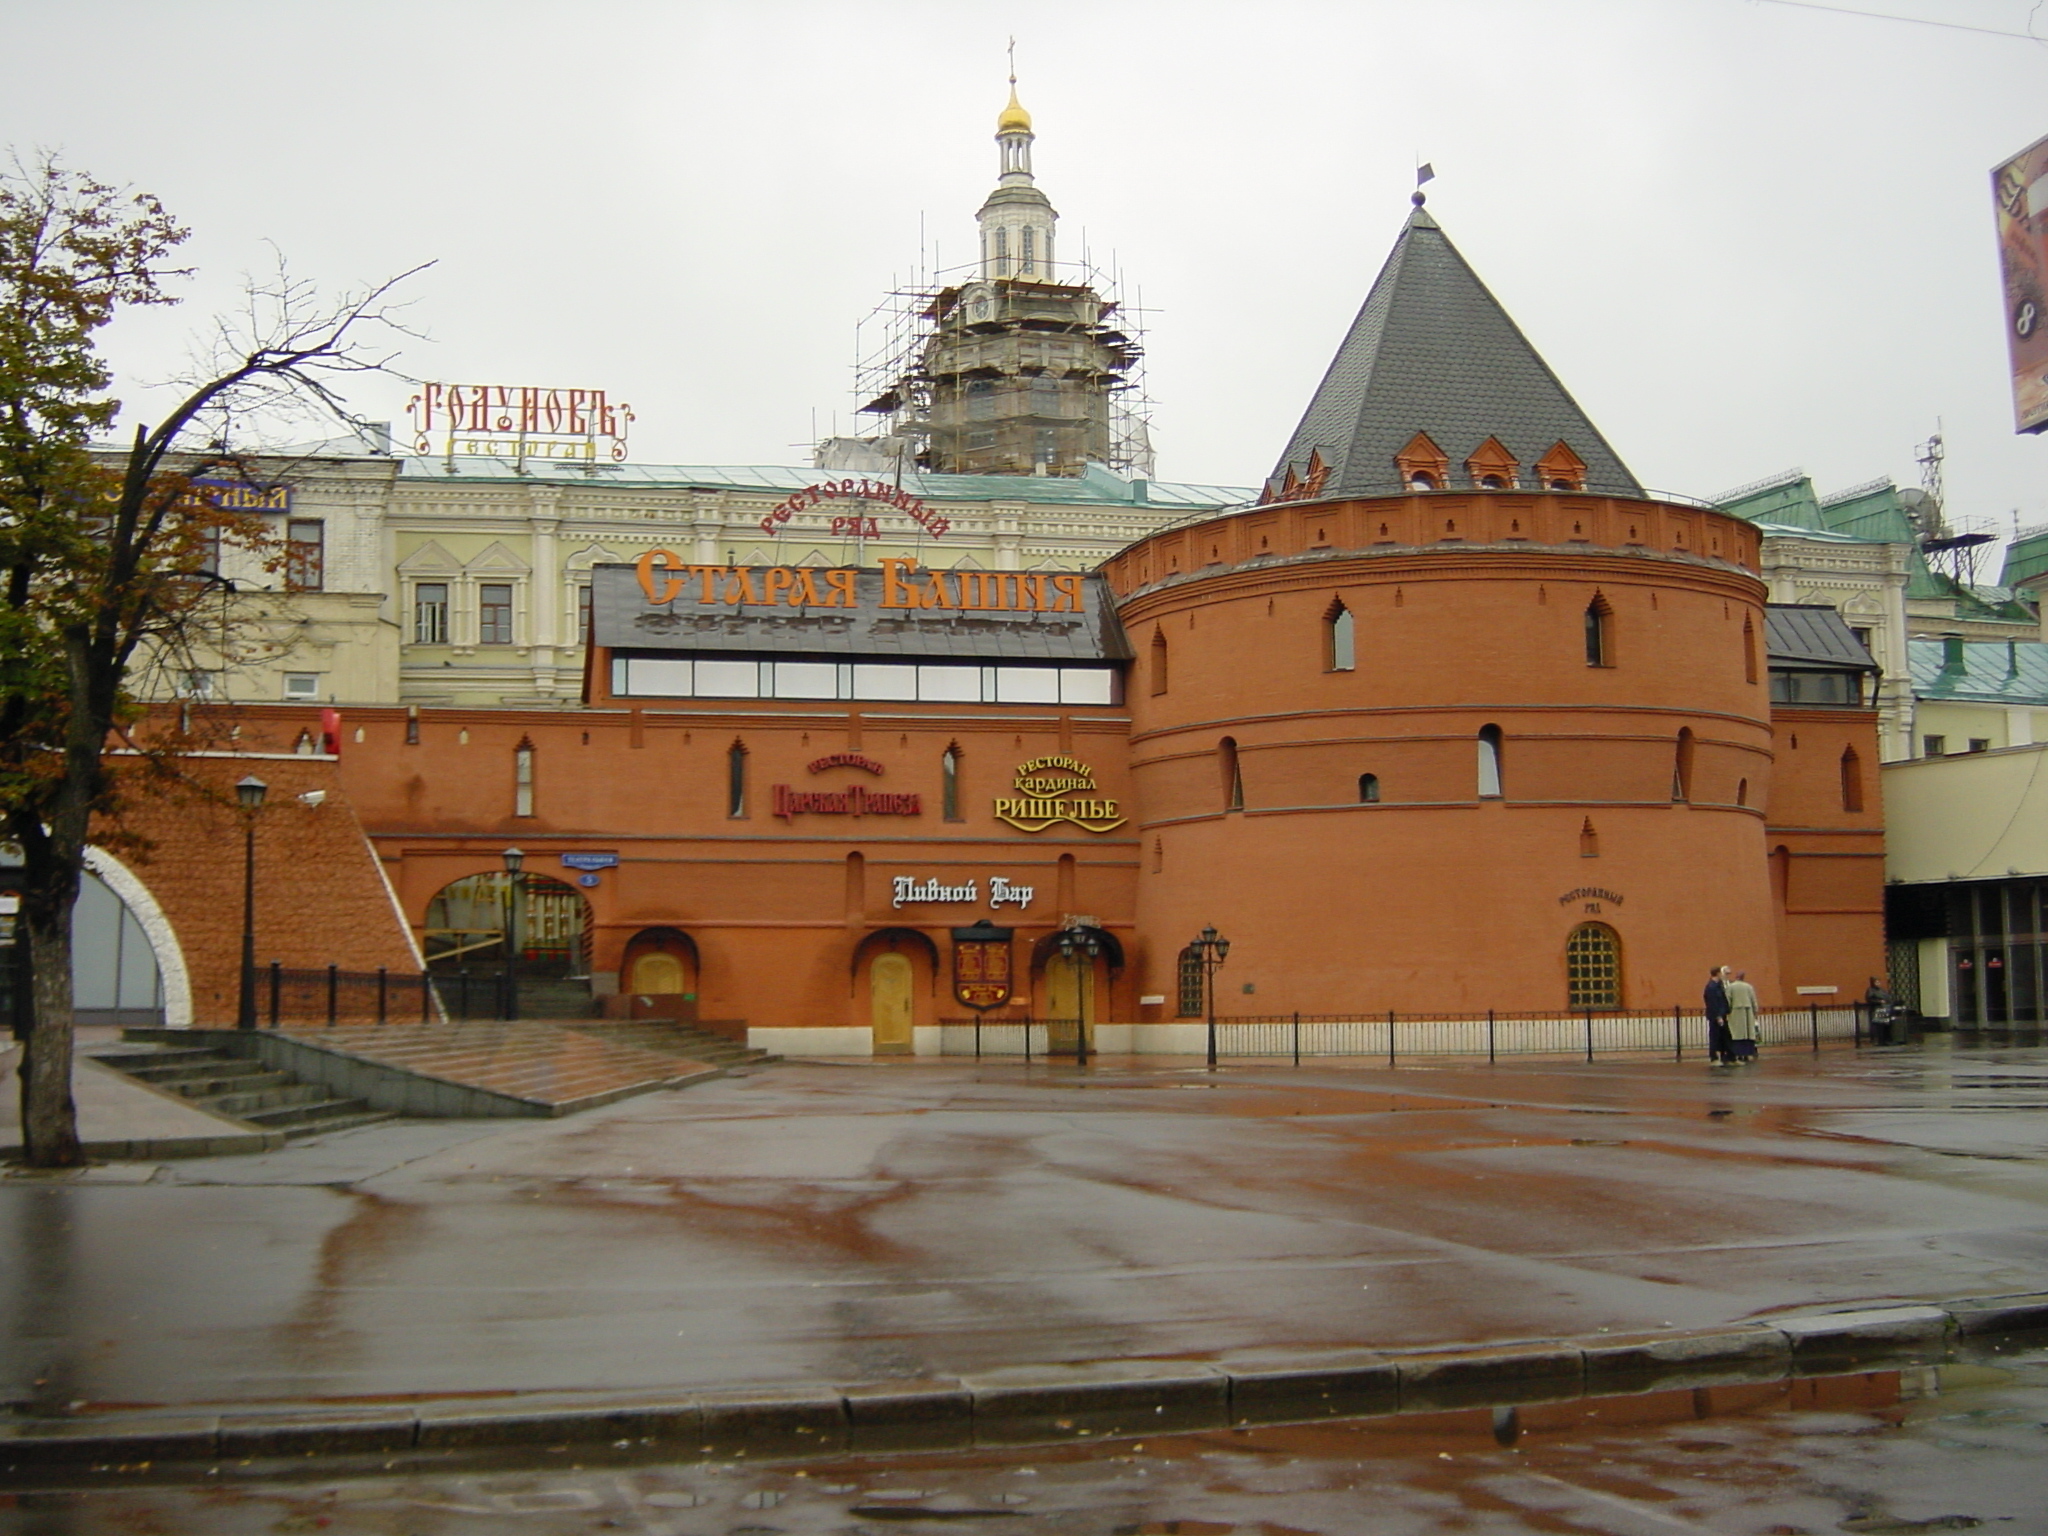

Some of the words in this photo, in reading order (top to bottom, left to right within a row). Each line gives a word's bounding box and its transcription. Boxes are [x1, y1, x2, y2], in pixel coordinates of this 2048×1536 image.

[424, 383, 616, 436] ГОДУНОВЪ
[760, 478, 951, 540] РЕСТОРАННЫЙ
[831, 516, 881, 540] РЯД
[807, 754, 885, 776] РЕСТОРАН
[1017, 756, 1092, 777] РЕСТОРАН
[1014, 777, 1097, 794] кардинал
[994, 798, 1120, 819] РИШЕЛЬЕ
[893, 876, 977, 909] Пивной
[989, 876, 1034, 909] Бар
